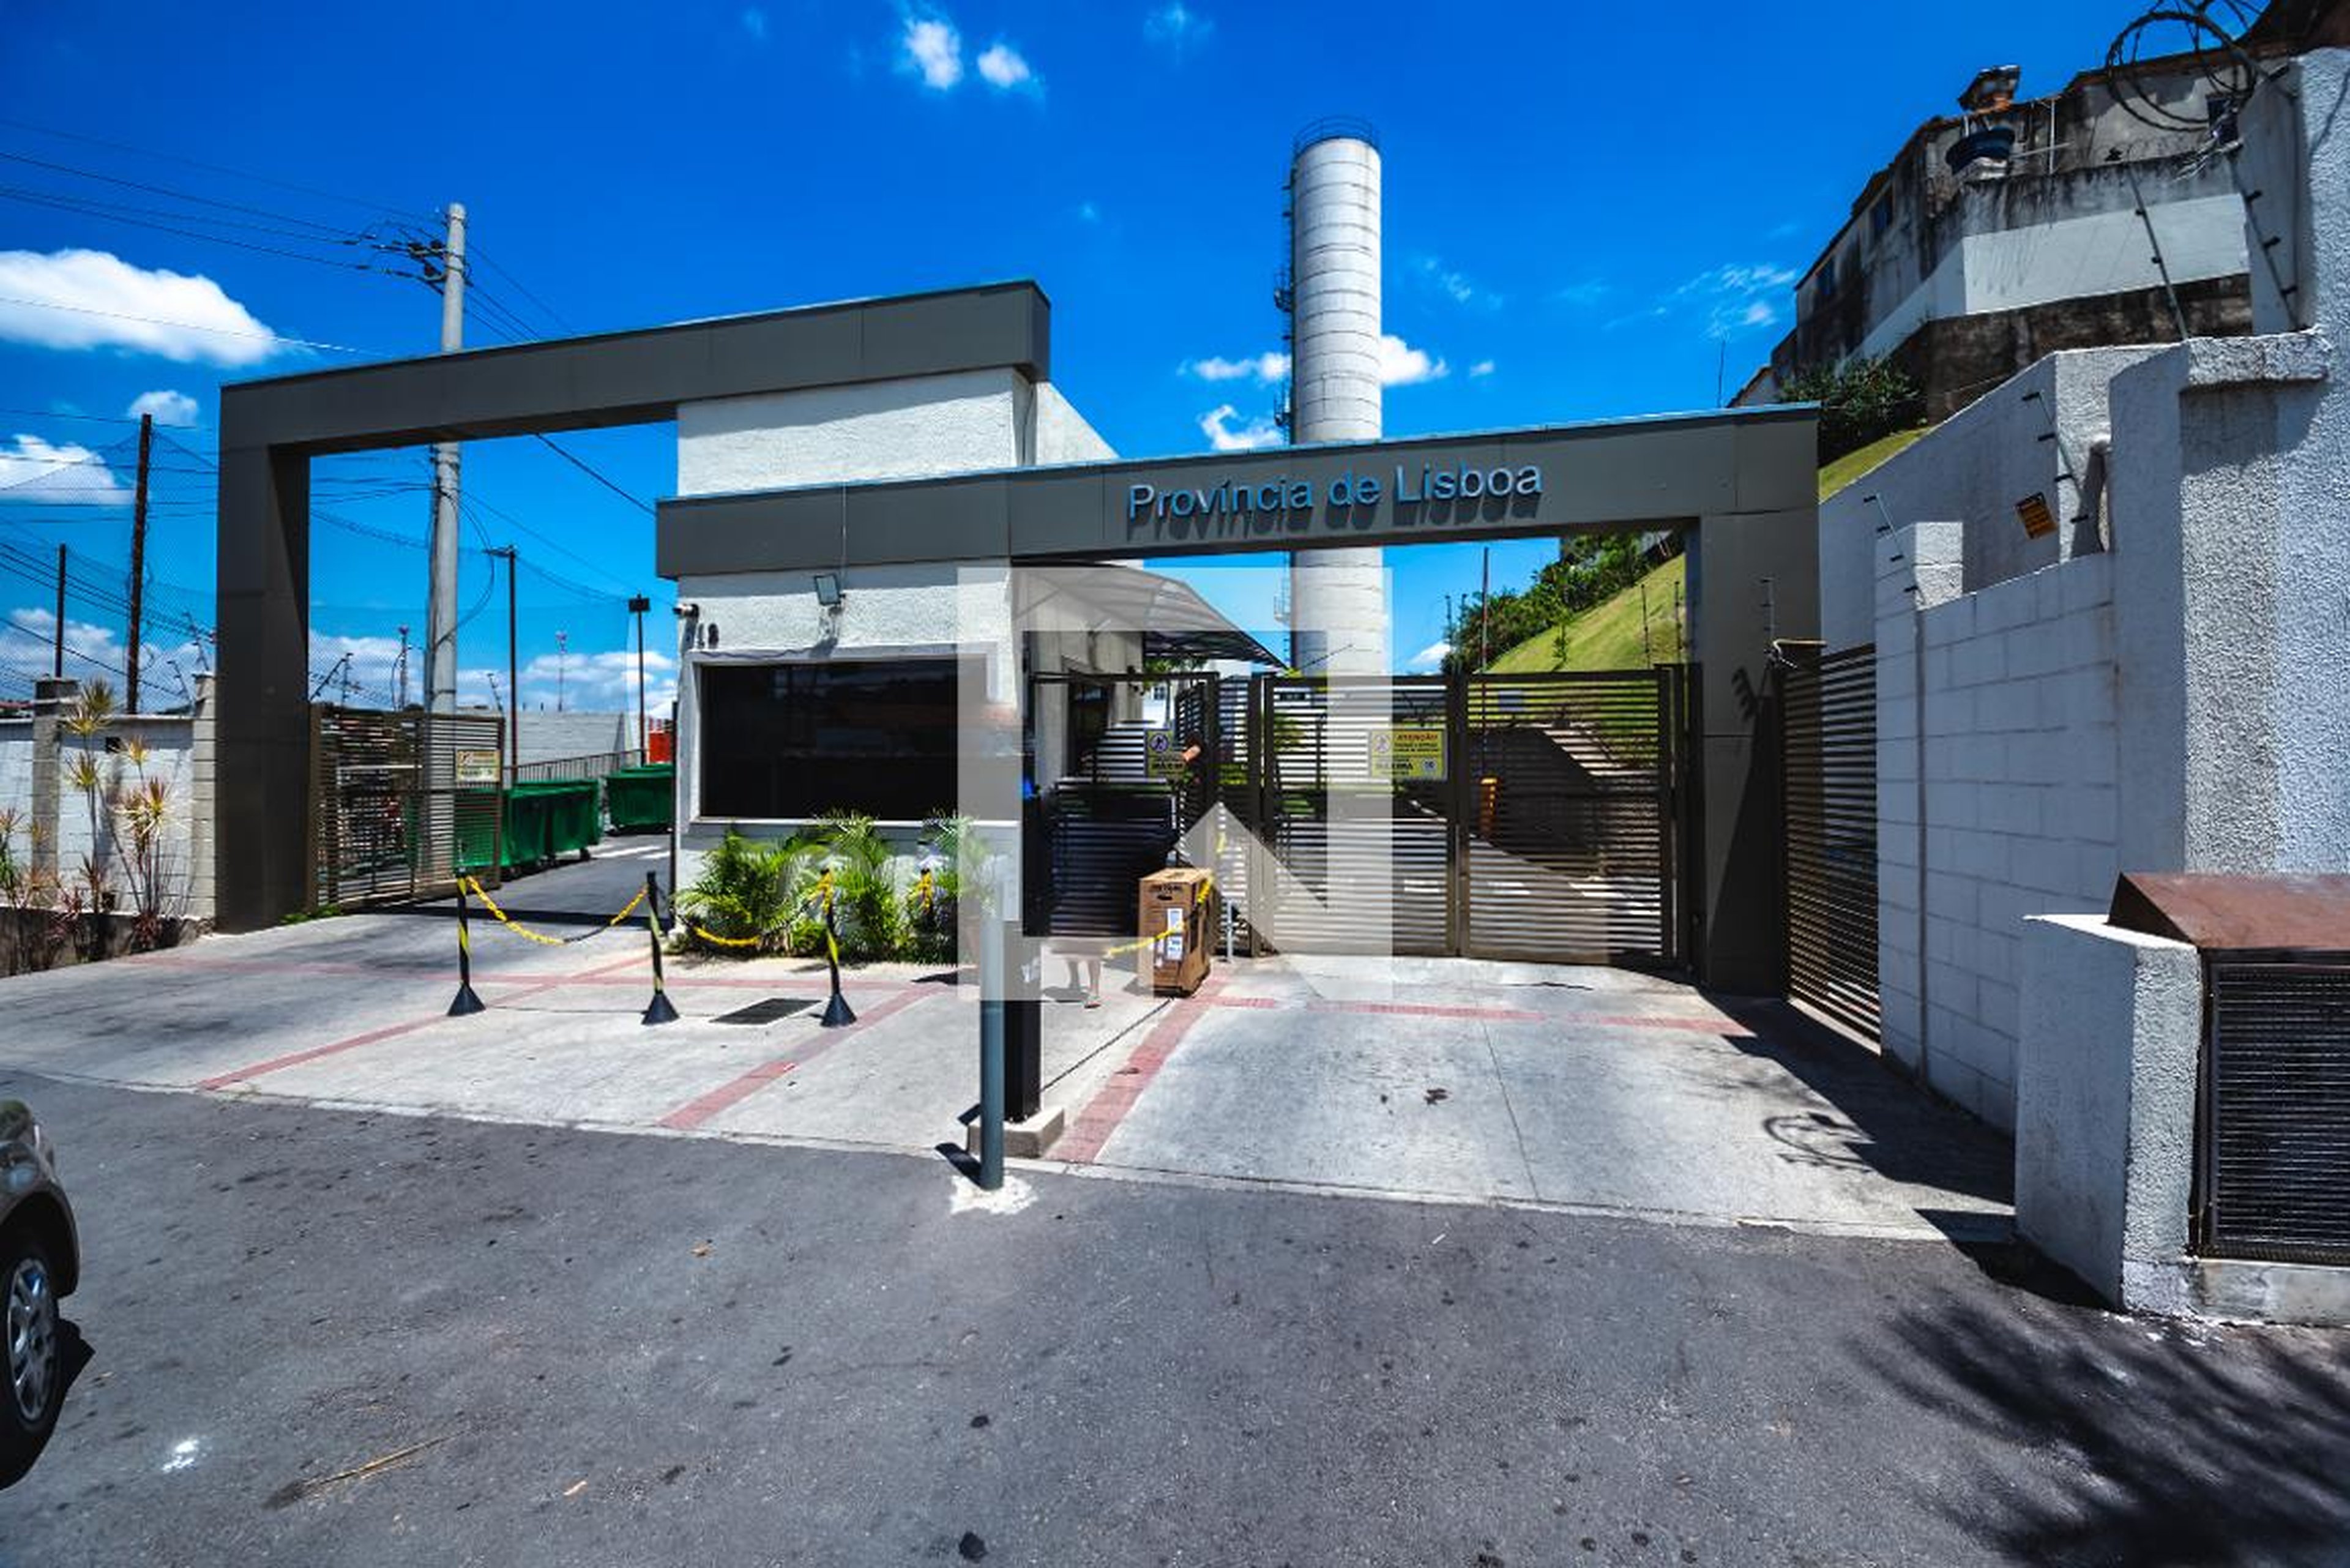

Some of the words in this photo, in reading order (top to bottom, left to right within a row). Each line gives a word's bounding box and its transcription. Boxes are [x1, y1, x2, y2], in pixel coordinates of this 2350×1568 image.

[1129, 480, 1314, 520] Província
[1329, 470, 1381, 507] de
[1395, 461, 1543, 503] Lisboa
